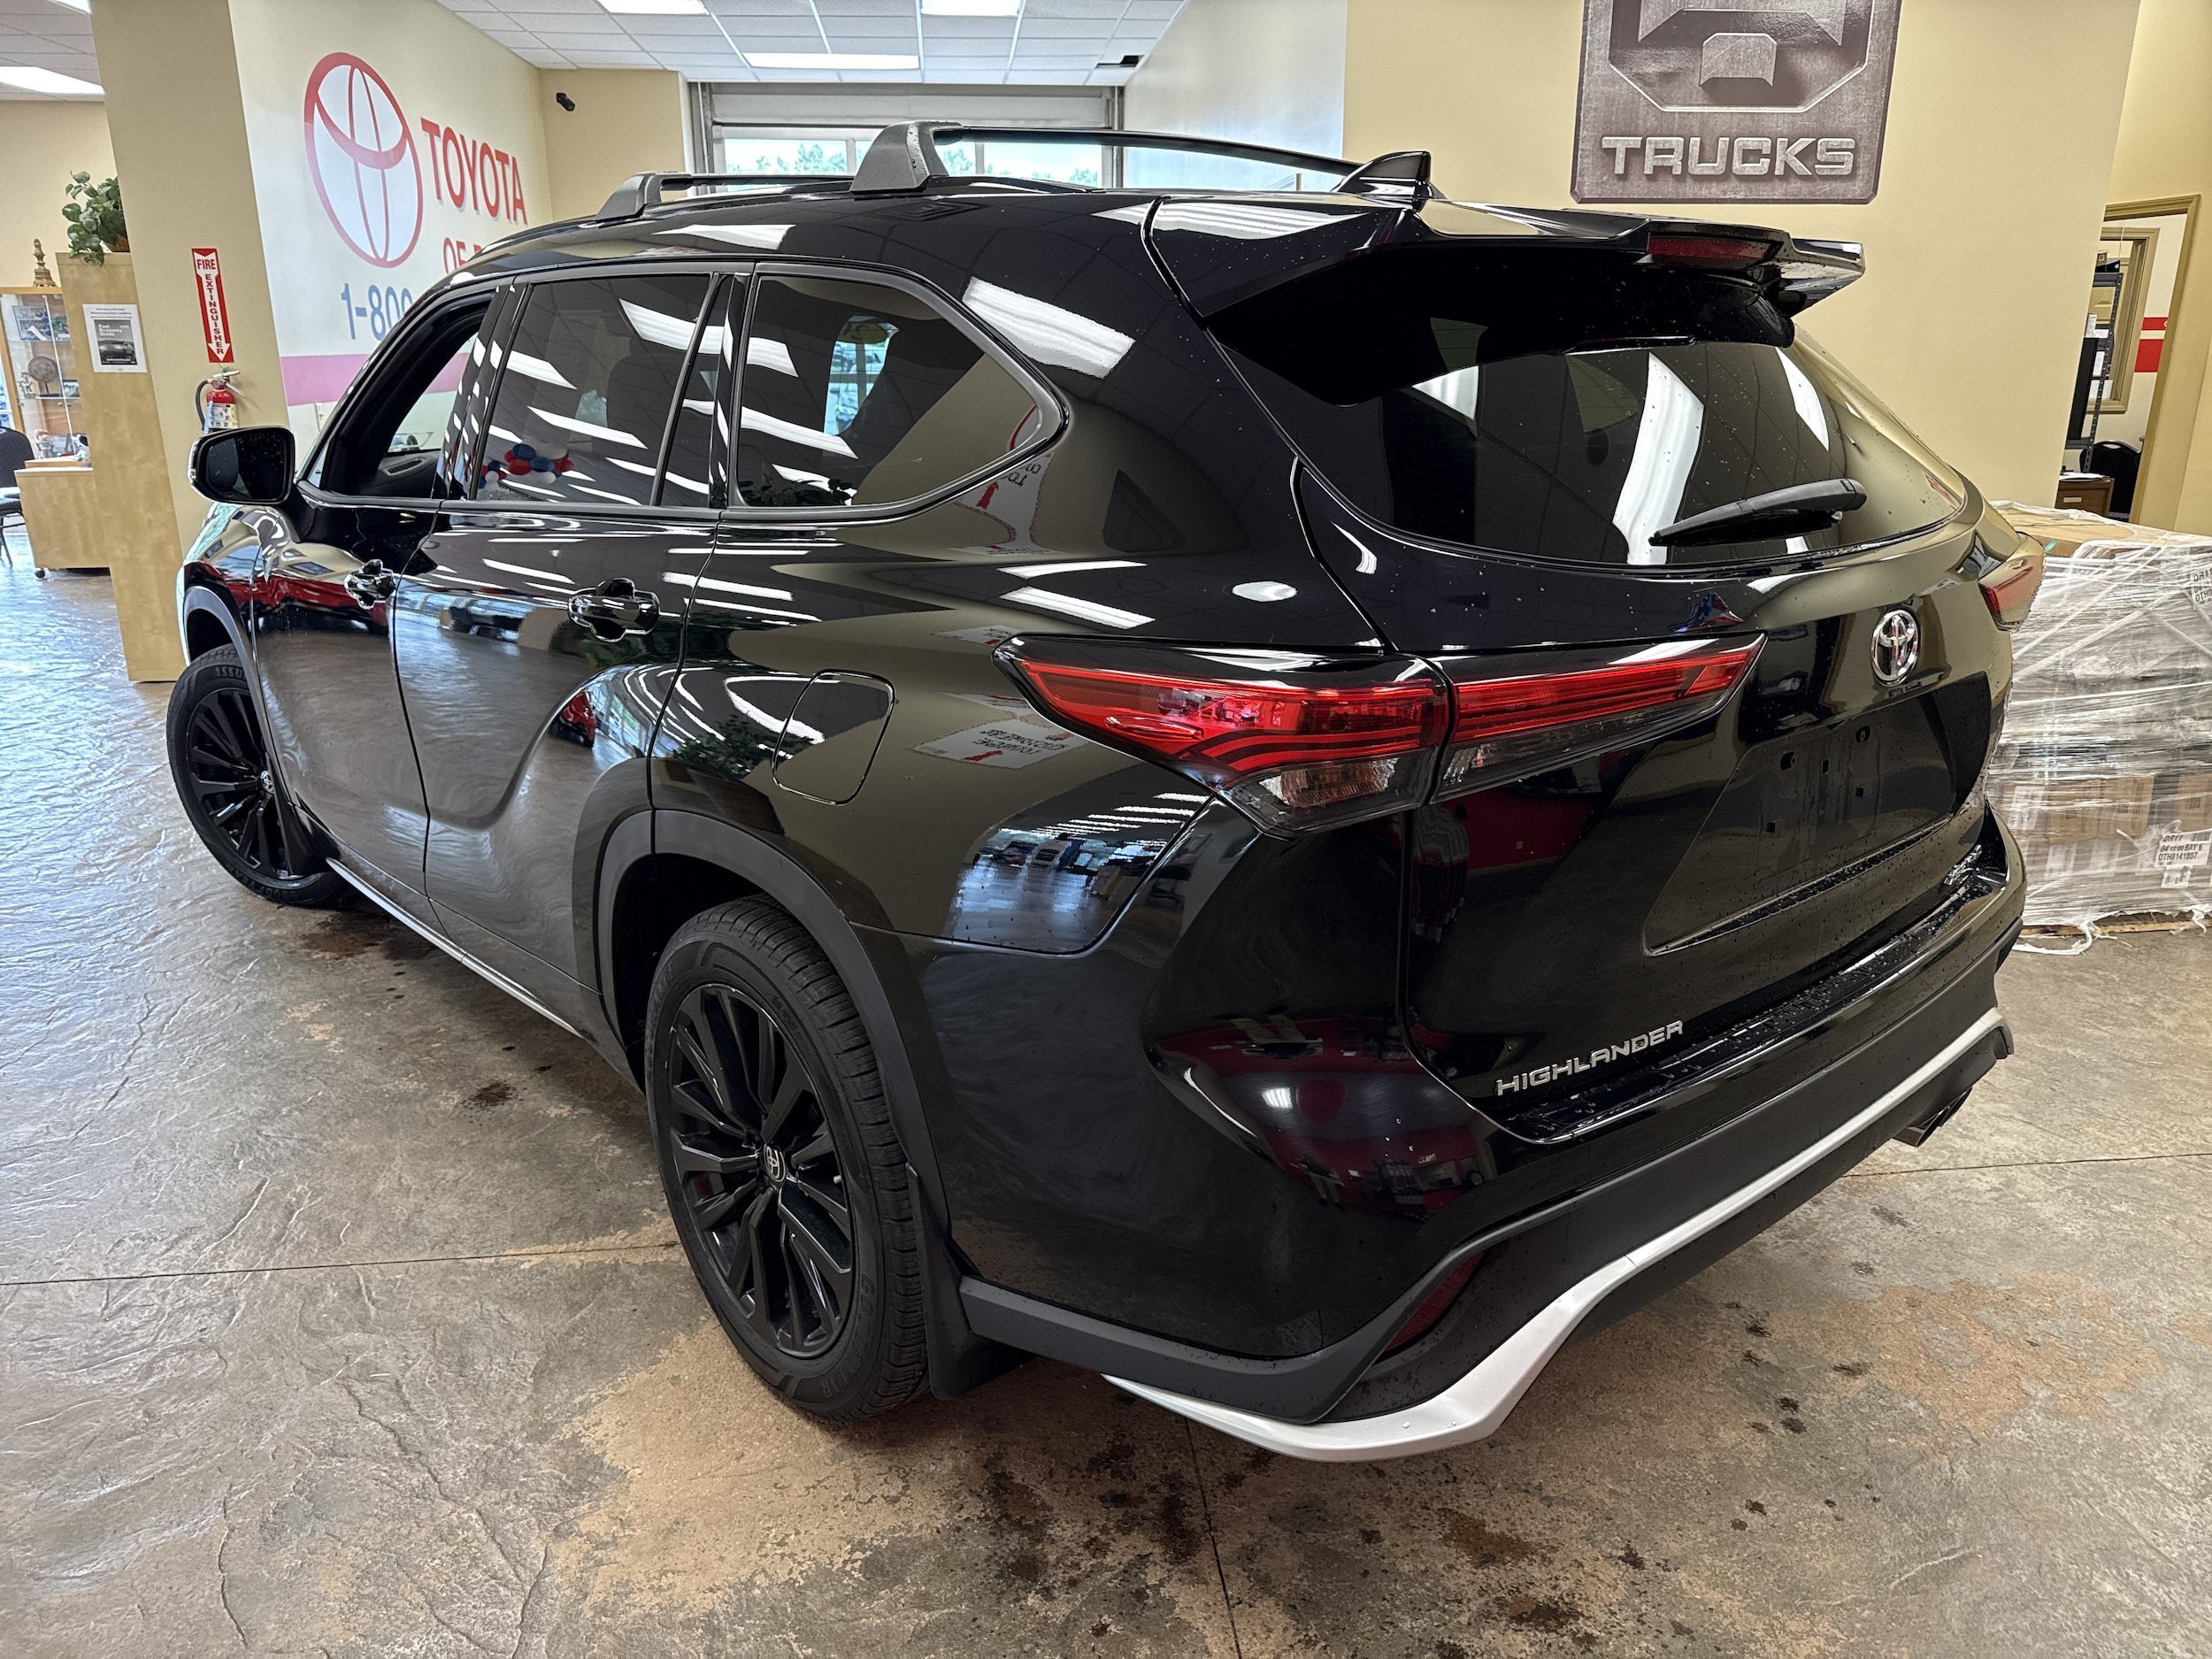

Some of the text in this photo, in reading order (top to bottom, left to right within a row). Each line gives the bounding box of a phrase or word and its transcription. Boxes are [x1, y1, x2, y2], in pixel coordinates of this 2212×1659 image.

[420, 117, 527, 225] TOYOTA
[1601, 136, 1856, 176] TRUCKS
[196, 258, 216, 270] FIRE
[205, 273, 224, 354] EXTINGUISHER
[1495, 1020, 1683, 1096] HIGHLANDER
